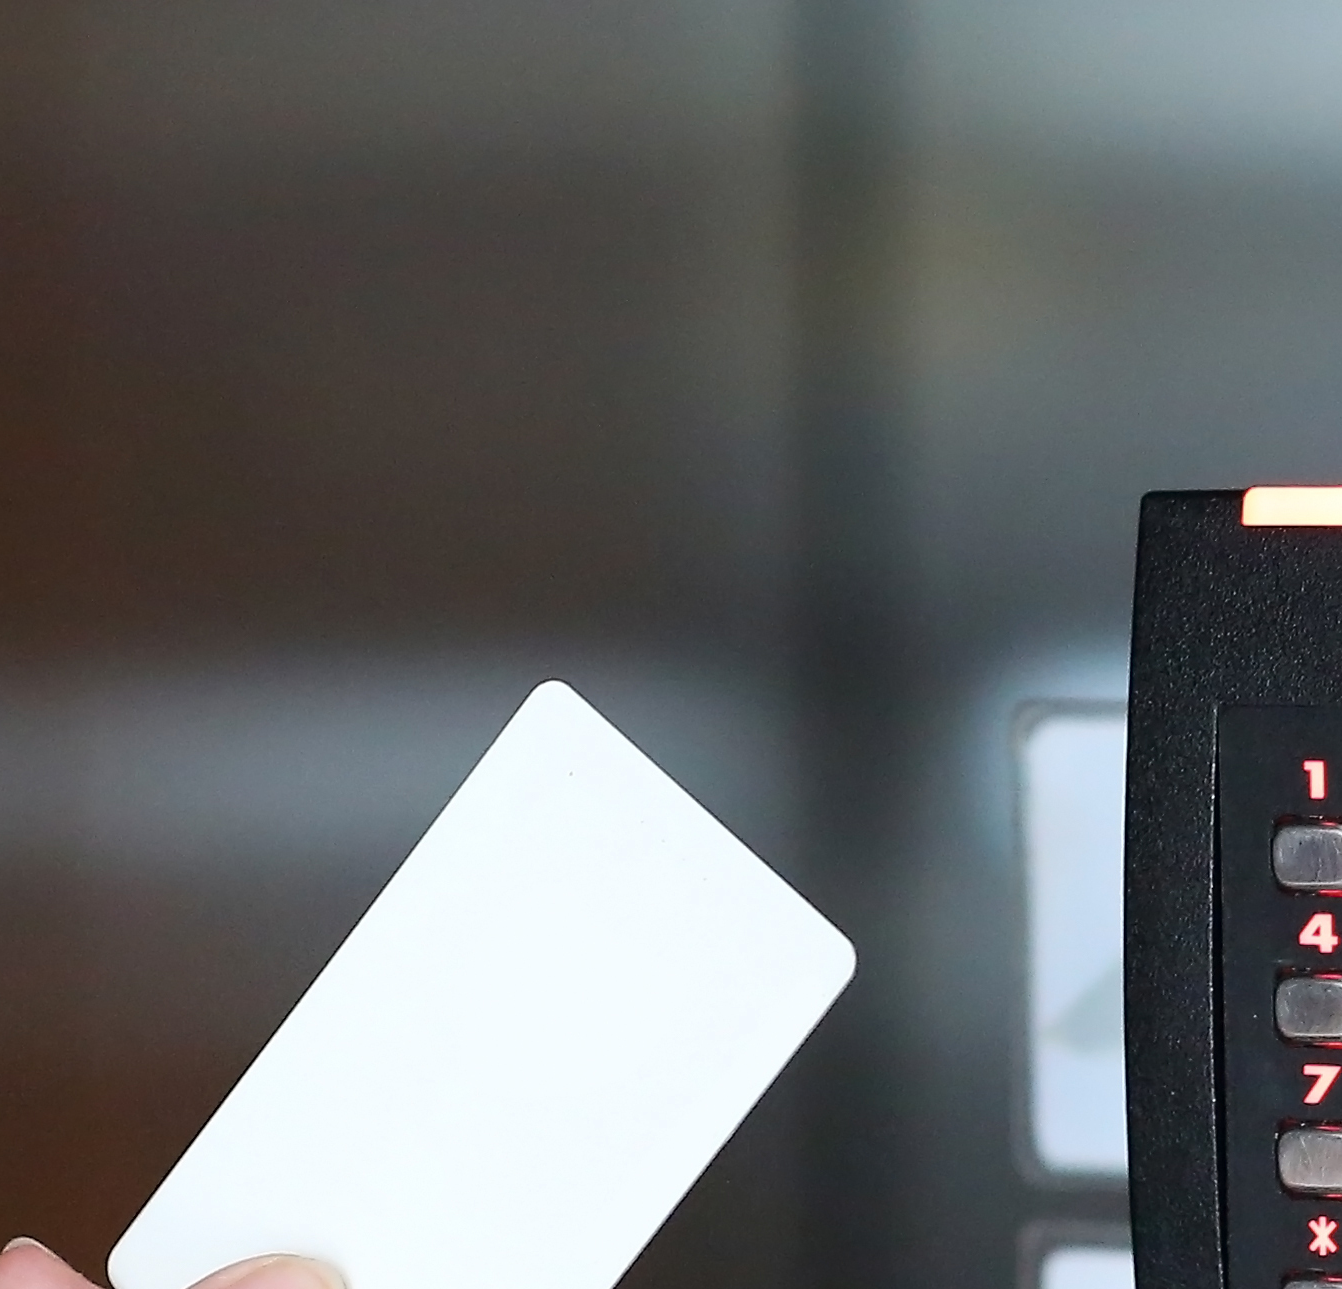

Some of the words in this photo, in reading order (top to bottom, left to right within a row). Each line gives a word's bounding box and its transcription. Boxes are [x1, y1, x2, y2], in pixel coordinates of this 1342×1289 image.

[1303, 760, 1326, 799] 1
[1299, 913, 1339, 954] 4
[1303, 1065, 1341, 1104] 7
